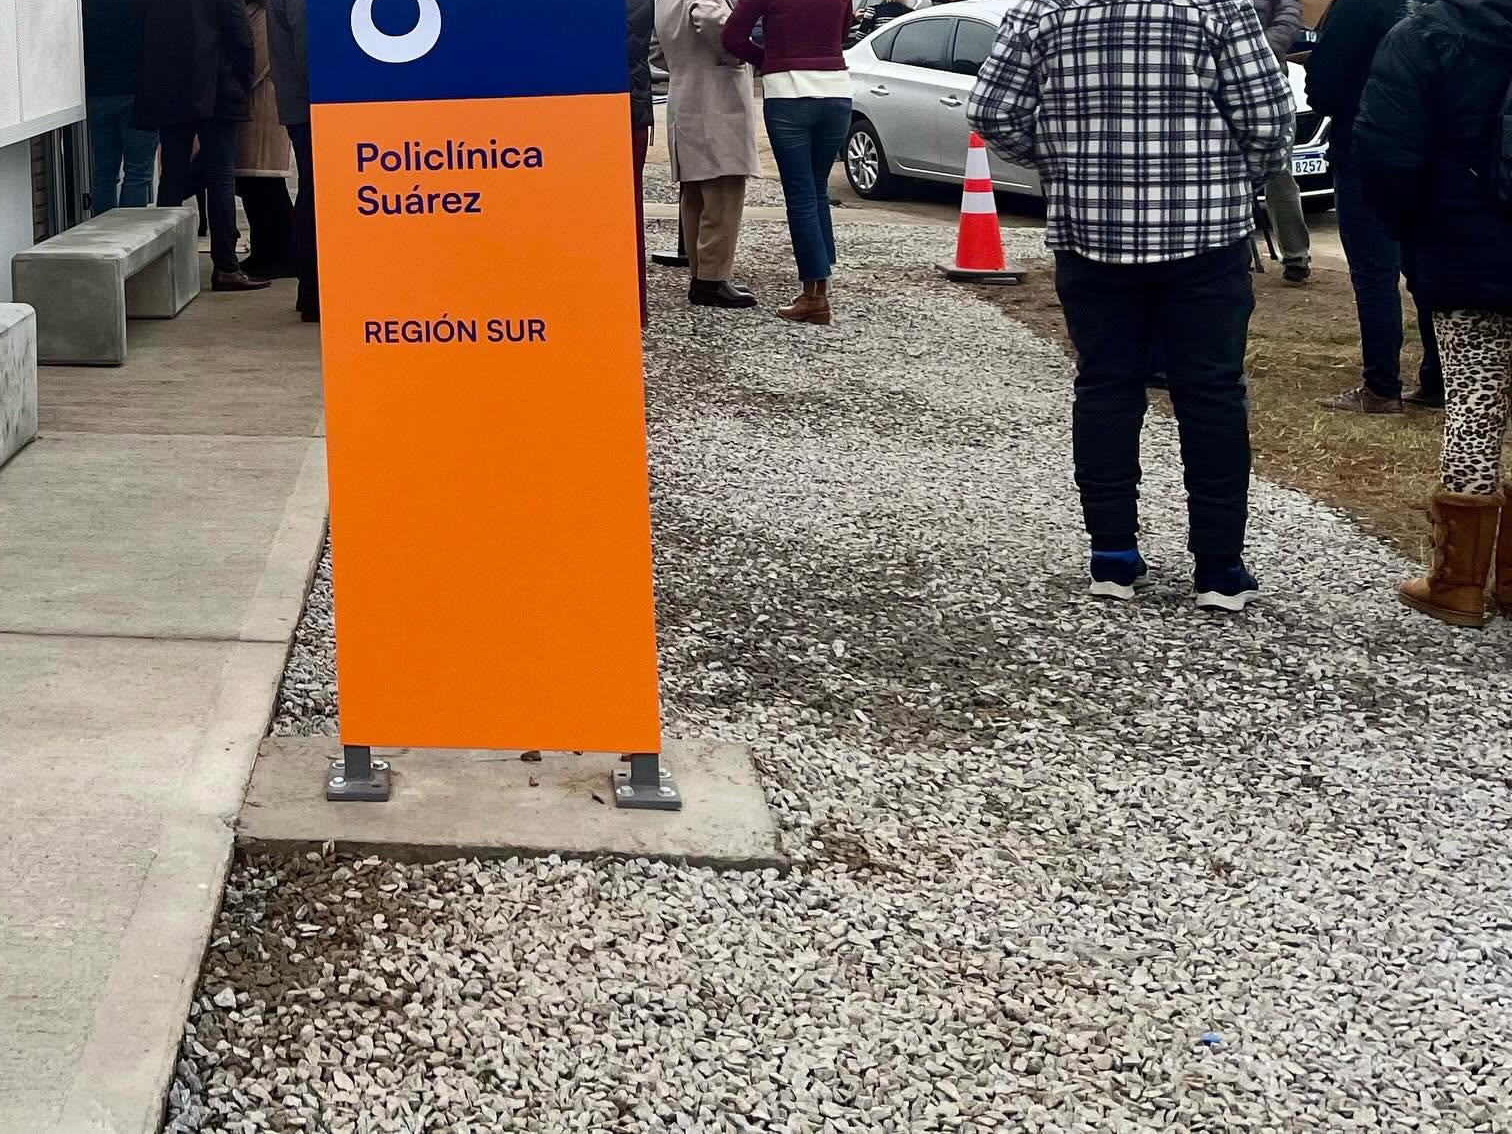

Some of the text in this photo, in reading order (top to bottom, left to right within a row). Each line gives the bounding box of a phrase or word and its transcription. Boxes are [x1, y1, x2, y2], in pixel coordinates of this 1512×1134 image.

[356, 139, 543, 172] Policlínica
[1296, 160, 1322, 173] 8257
[357, 184, 482, 216] Suárez
[365, 313, 546, 343] REGIÓN SUR
